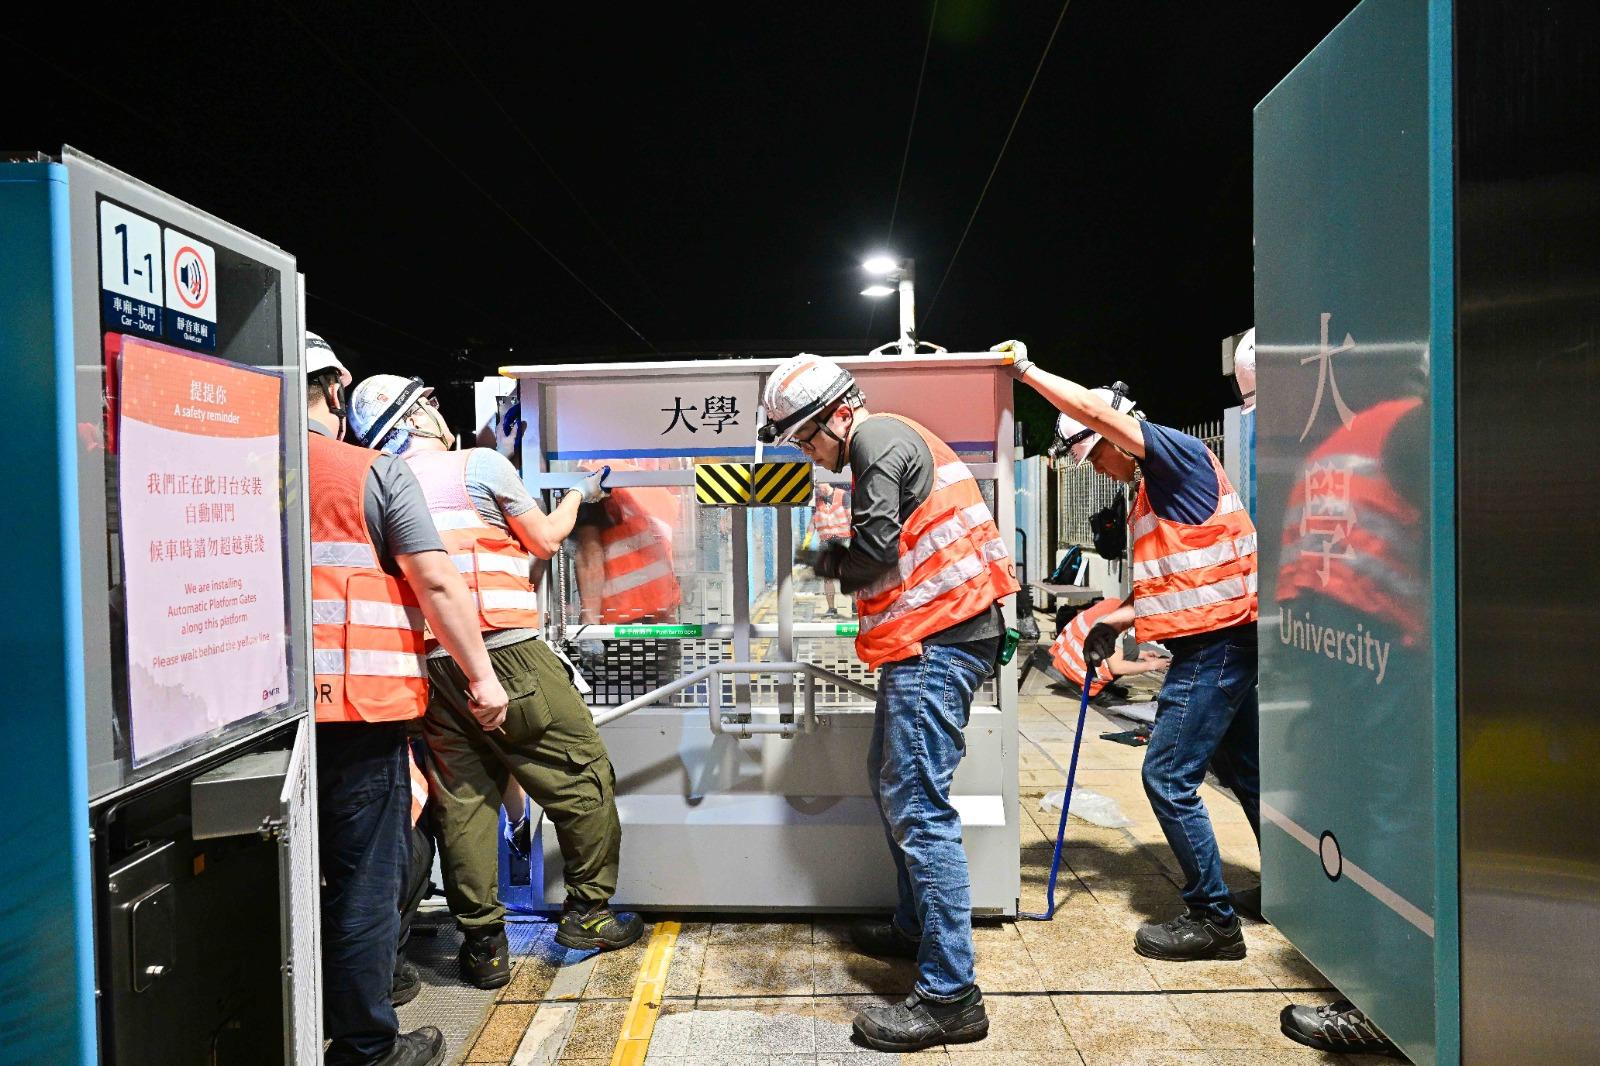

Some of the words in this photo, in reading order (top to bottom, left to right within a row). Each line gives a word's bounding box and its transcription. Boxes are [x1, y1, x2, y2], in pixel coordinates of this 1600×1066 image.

[114, 223, 153, 293] 1-1
[190, 379, 227, 405] 提提你
[173, 403, 181, 416] A
[182, 406, 205, 422] safety
[207, 411, 240, 425] reminder
[661, 395, 740, 436] 大學
[1300, 312, 1357, 587] 大學
[147, 472, 262, 496] 我們正在此月台安裝
[185, 502, 235, 525] 自動閘門
[184, 583, 197, 594] We
[198, 583, 210, 593] are
[211, 577, 243, 590] installing
[167, 600, 208, 617] Automatic
[209, 596, 238, 611] Platform
[239, 594, 257, 605] Gates
[181, 621, 203, 636] along
[204, 617, 219, 629] this
[220, 612, 248, 630] platform
[152, 655, 179, 668] Please
[180, 648, 198, 662] wait
[199, 642, 225, 657] behind
[1279, 606, 1391, 686] University
